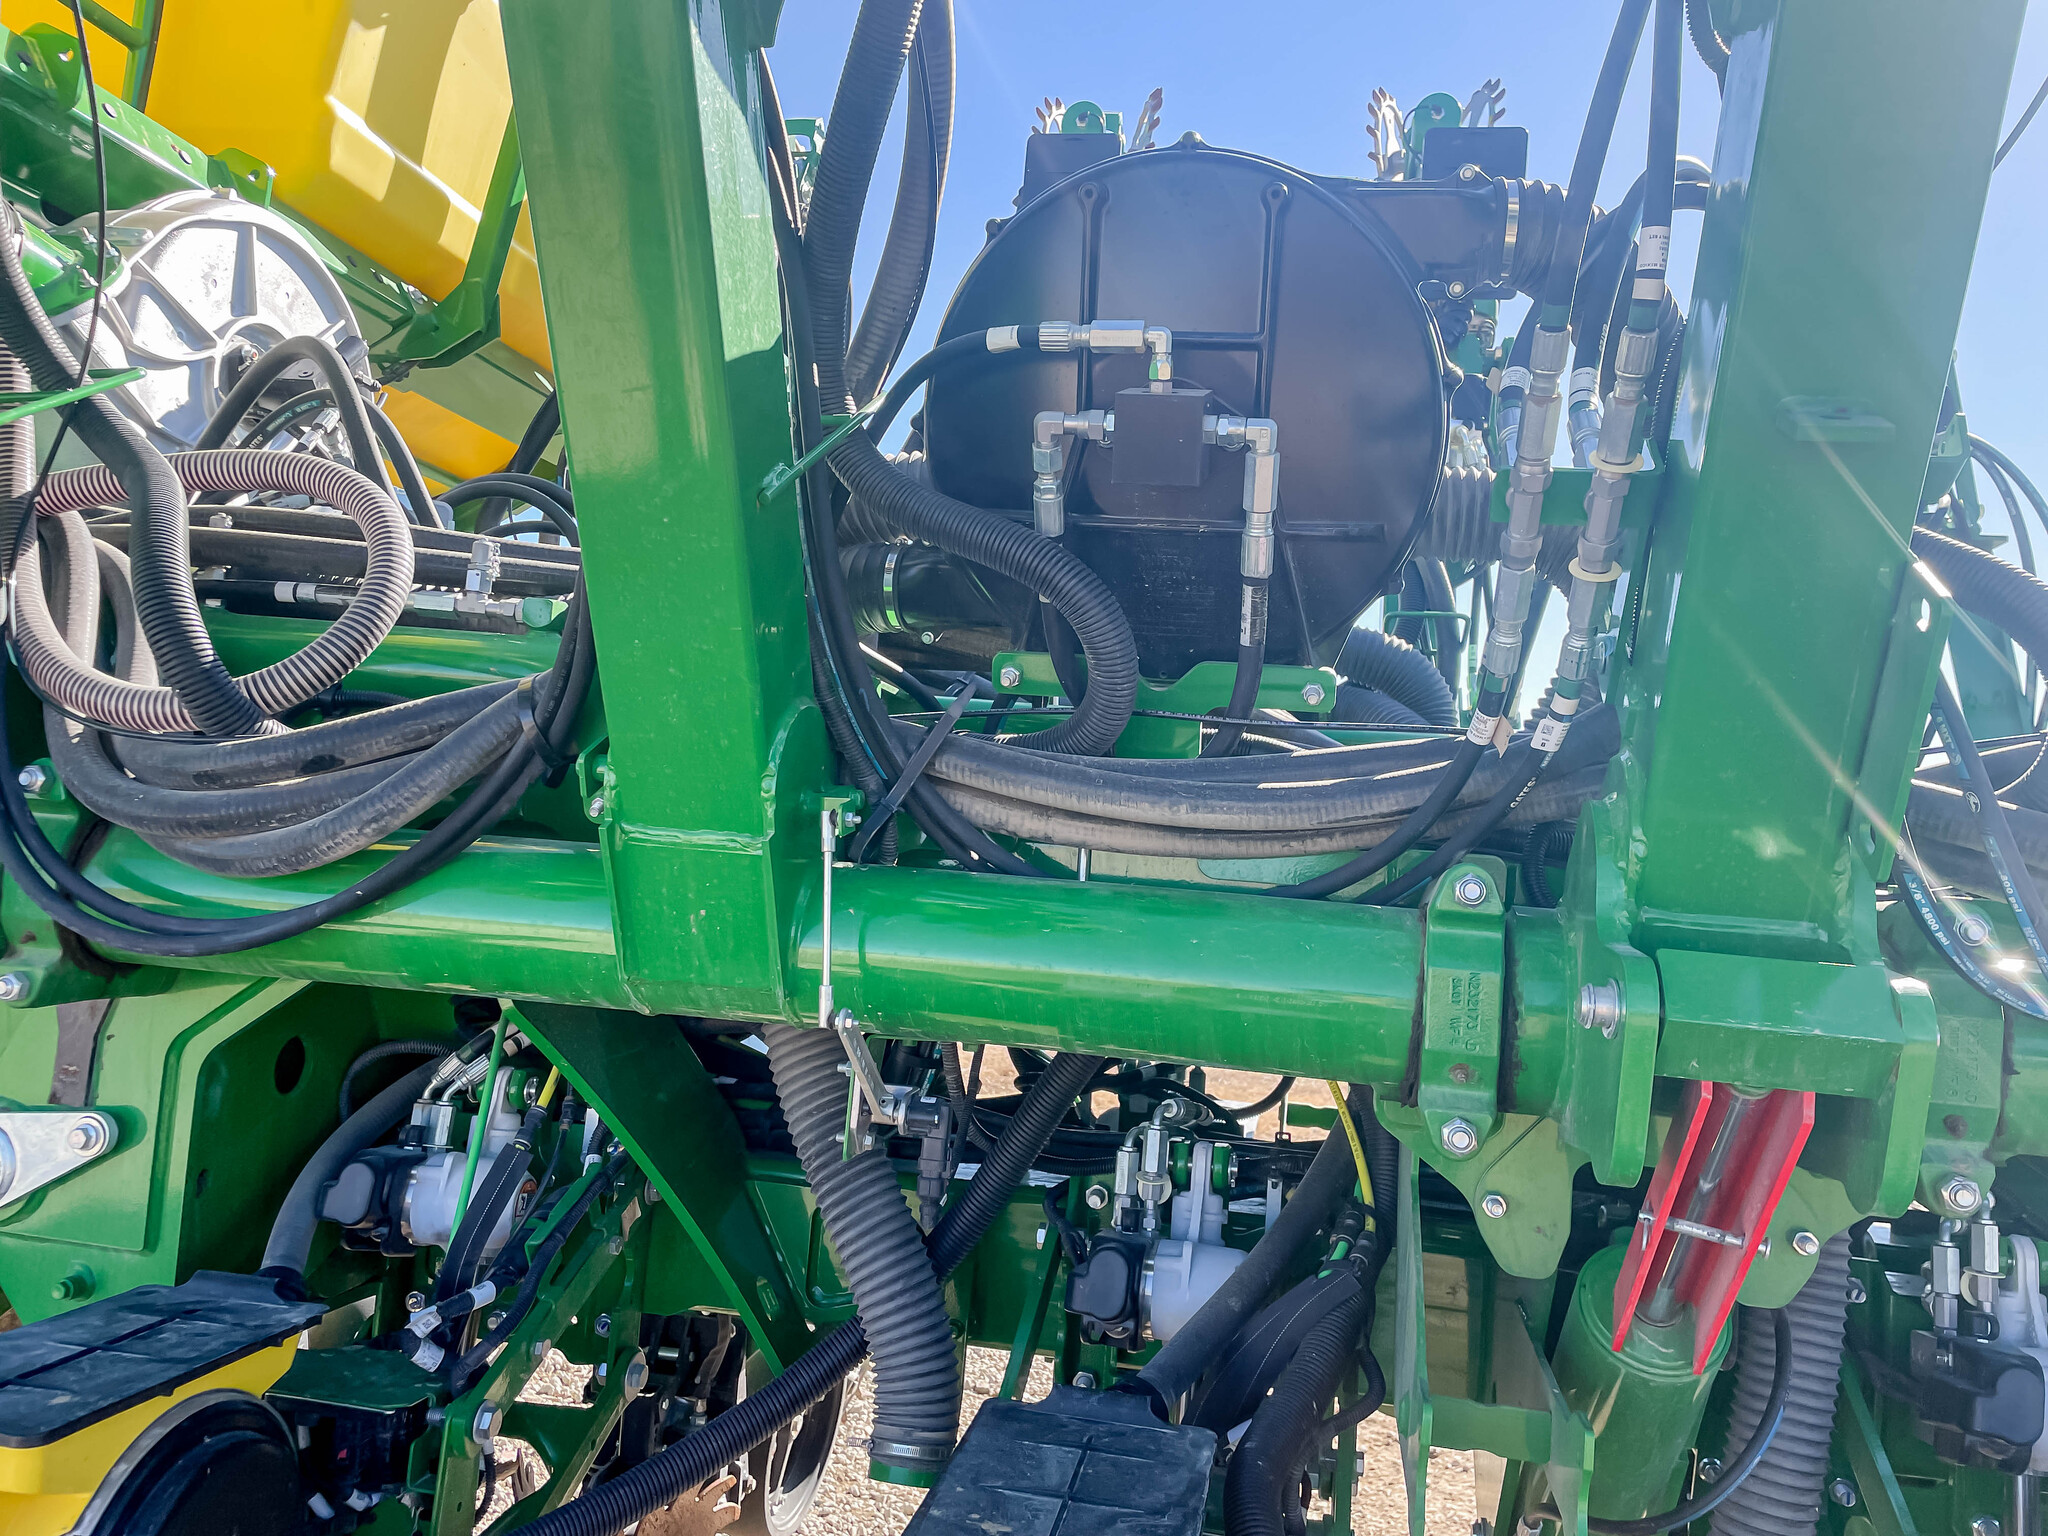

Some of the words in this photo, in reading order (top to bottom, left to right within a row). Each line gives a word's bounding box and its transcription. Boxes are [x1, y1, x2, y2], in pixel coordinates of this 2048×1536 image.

[1510, 778, 1536, 808] GATES
[1908, 881, 1926, 904] 3/8"
[1921, 907, 1940, 931] 4800
[1935, 931, 1951, 946] psi
[1466, 972, 1481, 1031] N232173
